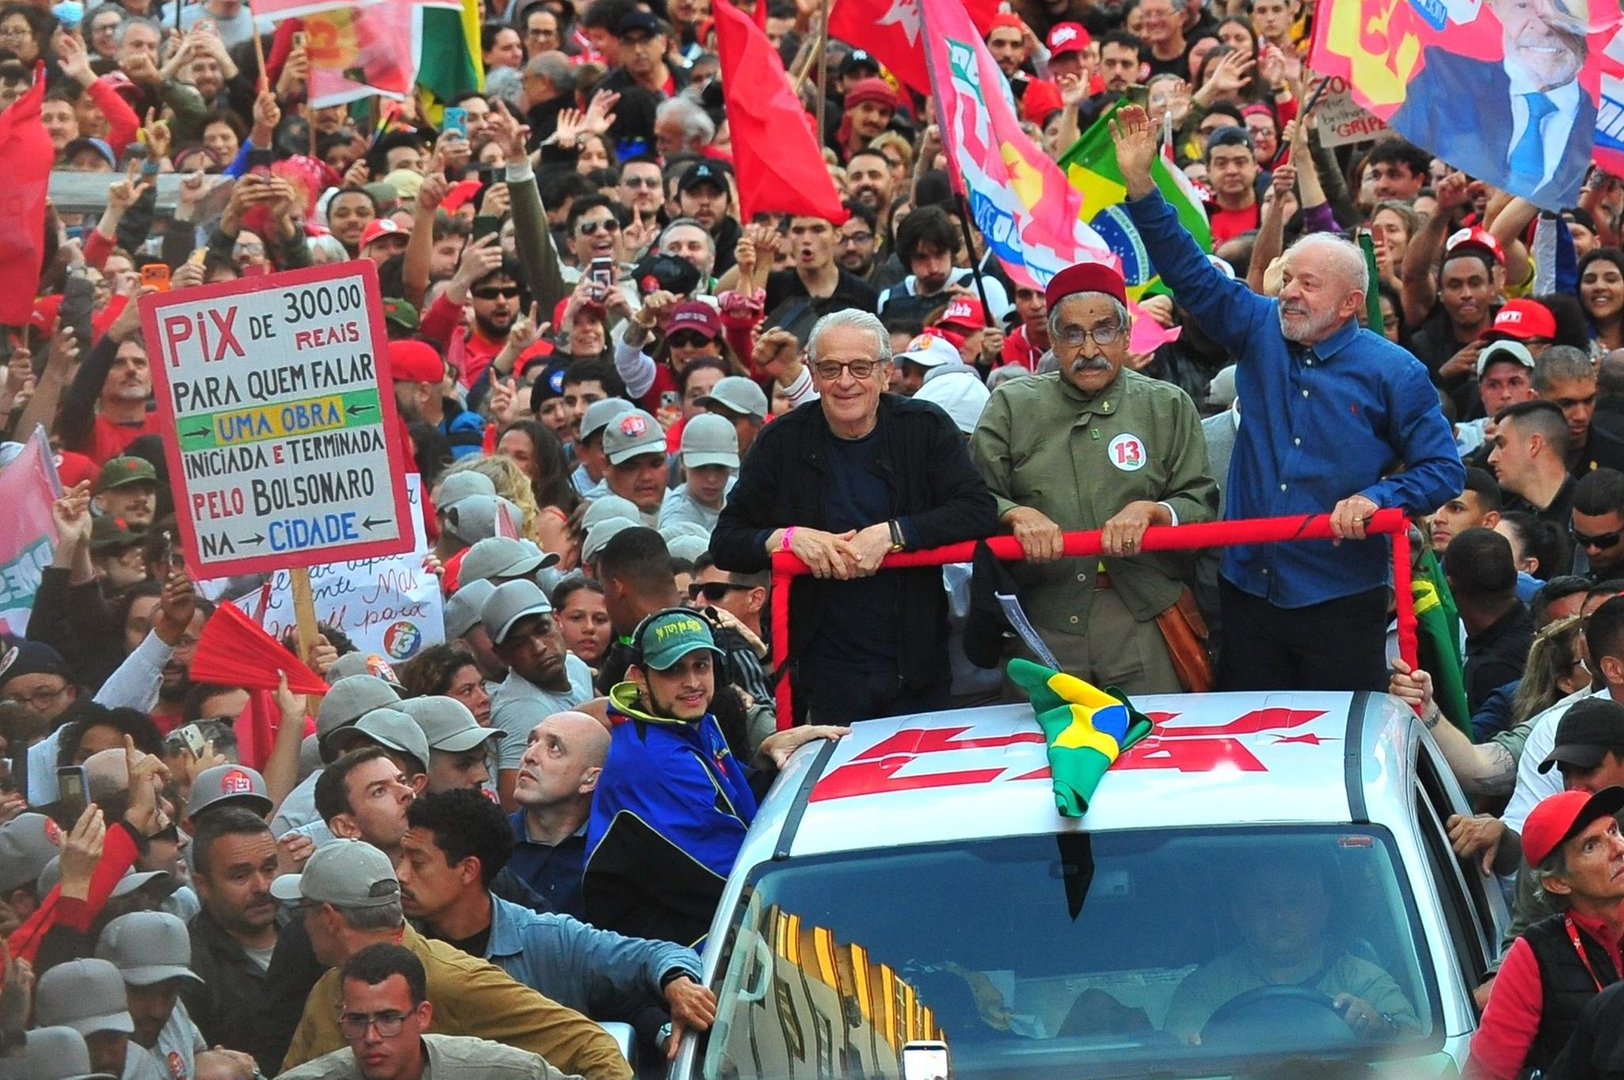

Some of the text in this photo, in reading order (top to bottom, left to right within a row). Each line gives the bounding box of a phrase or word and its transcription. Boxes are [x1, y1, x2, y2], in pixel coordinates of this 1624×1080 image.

[250, 314, 277, 341] DE
[283, 283, 362, 325] 300.00
[173, 352, 376, 413] PARA QUEM FALAR
[218, 401, 343, 443] UMA OBRA
[272, 444, 286, 465] E
[1115, 440, 1141, 464] 13
[192, 467, 375, 522] PELO BOLSONARO
[201, 531, 236, 560] NA
[354, 601, 428, 635] para
